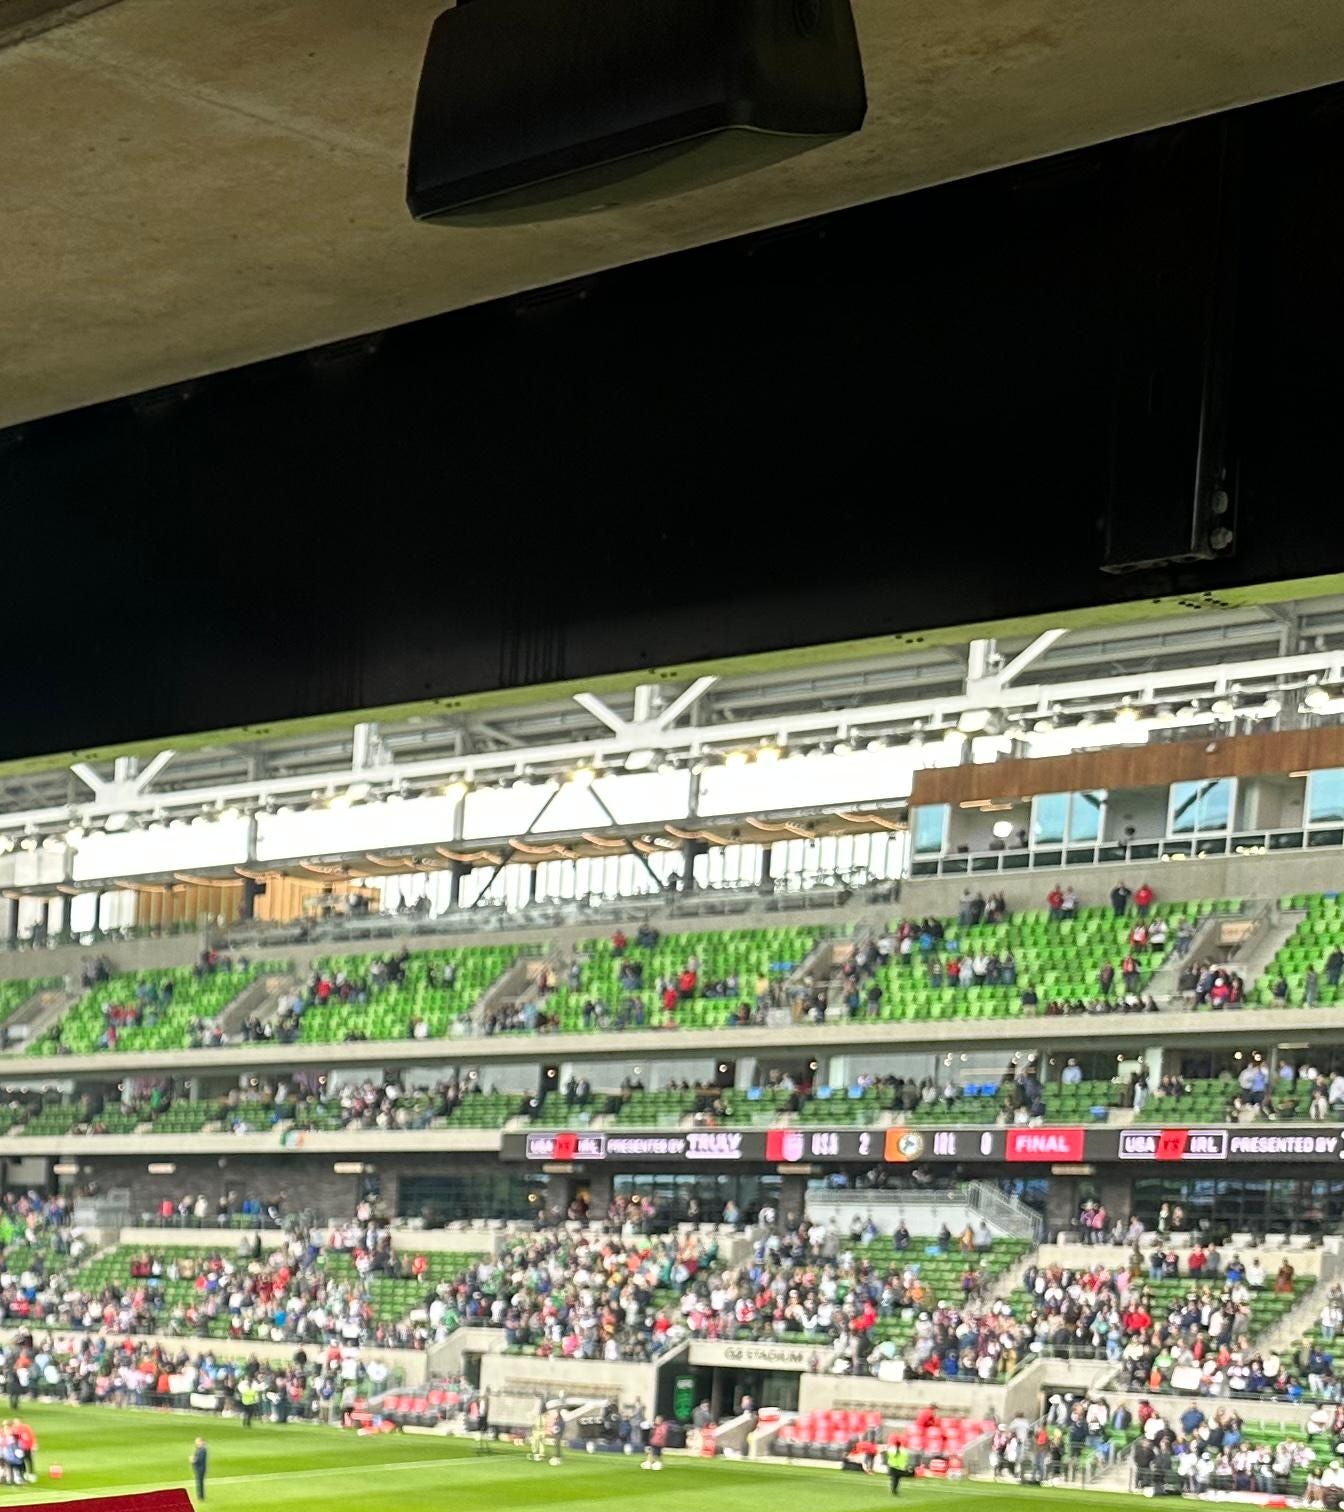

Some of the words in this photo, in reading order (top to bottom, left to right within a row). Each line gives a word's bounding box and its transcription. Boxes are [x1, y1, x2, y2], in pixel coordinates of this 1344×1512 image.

[1014, 1135, 1071, 1153] FINAL
[1125, 1136, 1156, 1153] USA
[1190, 1136, 1218, 1153] IRL
[1230, 1136, 1314, 1153] PRESENTED
[1315, 1136, 1338, 1152] BY
